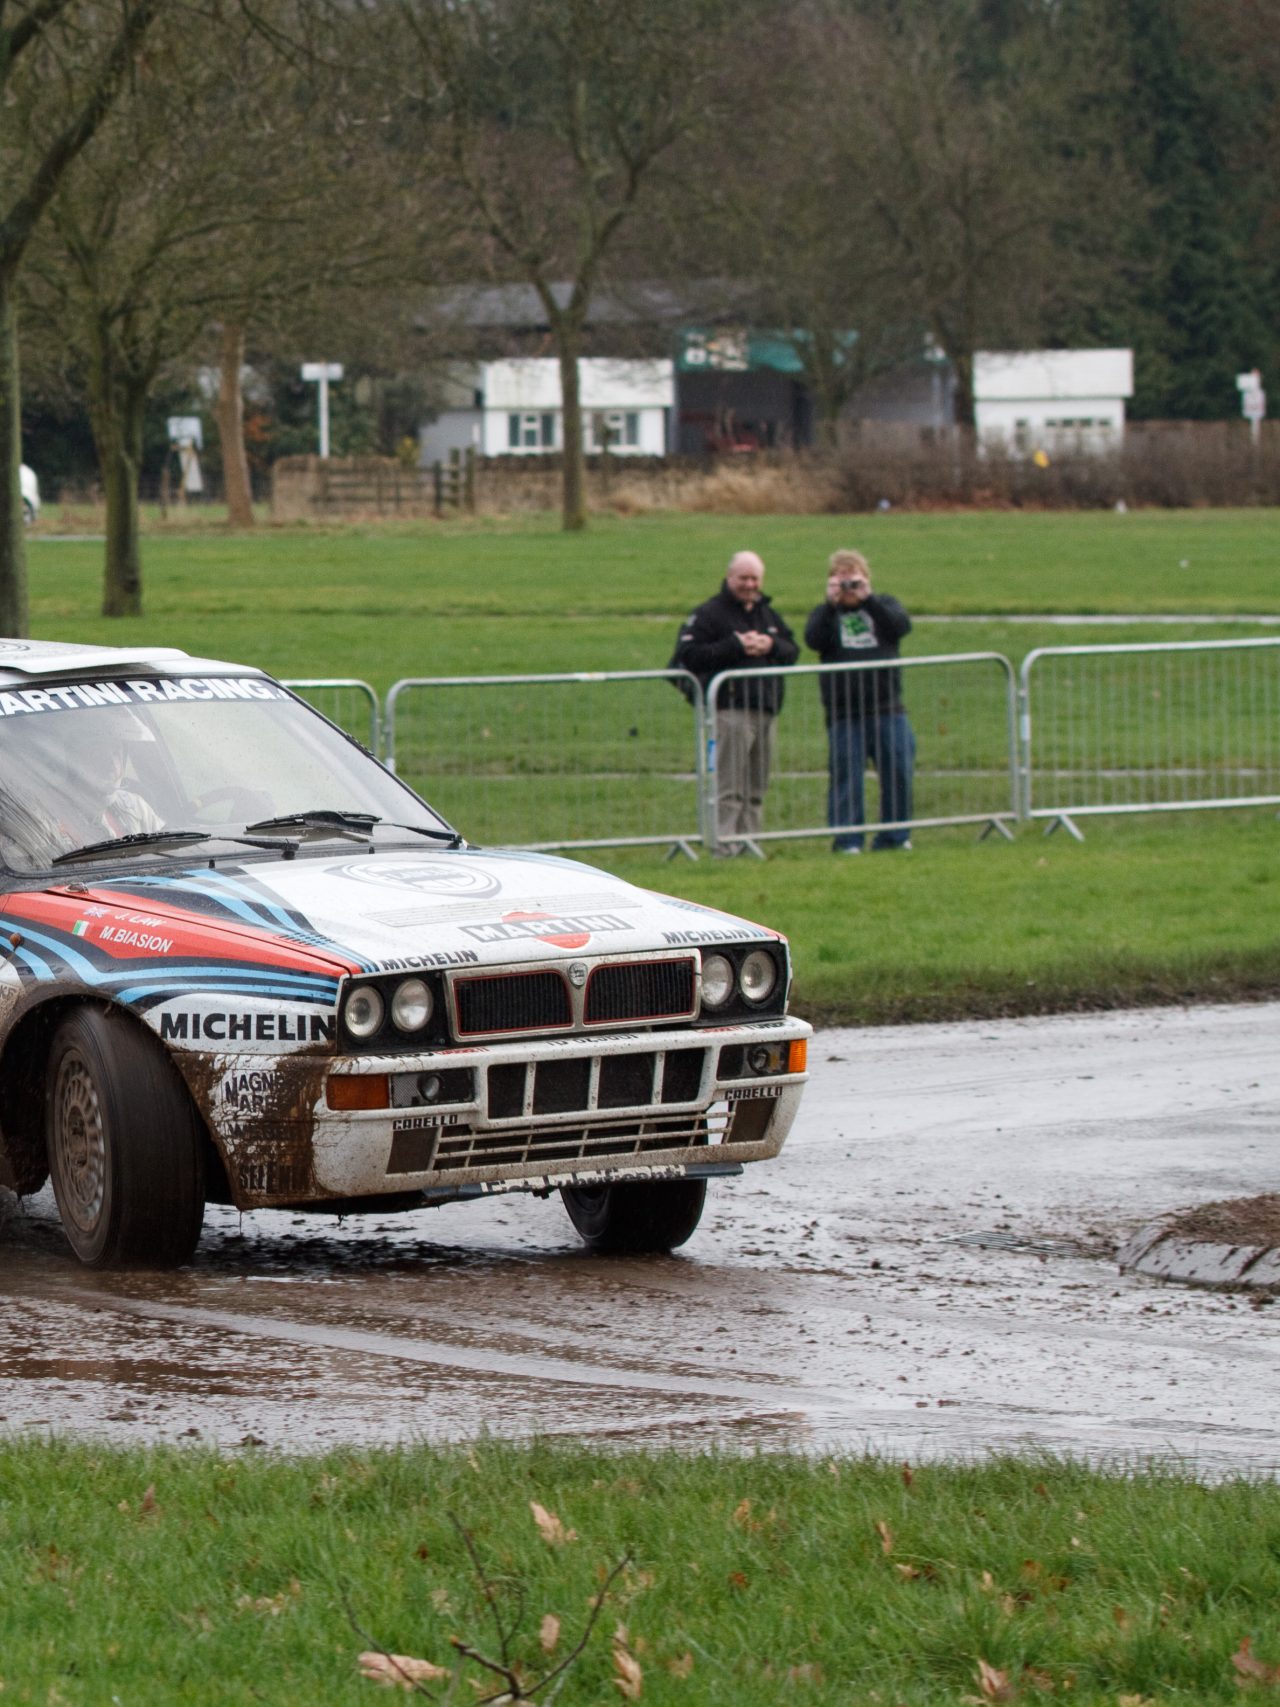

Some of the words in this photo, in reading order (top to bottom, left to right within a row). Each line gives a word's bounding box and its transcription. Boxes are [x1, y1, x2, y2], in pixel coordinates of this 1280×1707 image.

[127, 678, 277, 701] RACING
[128, 914, 167, 928] LAW
[463, 915, 628, 942] MARTINI
[99, 925, 173, 953] M.BIASION
[661, 929, 750, 945] MICHELIN
[379, 950, 479, 971] MICHELIN
[160, 1013, 337, 1041] MICHELIN
[724, 1086, 783, 1101] CARELLO
[392, 1114, 458, 1131] CARELLO
